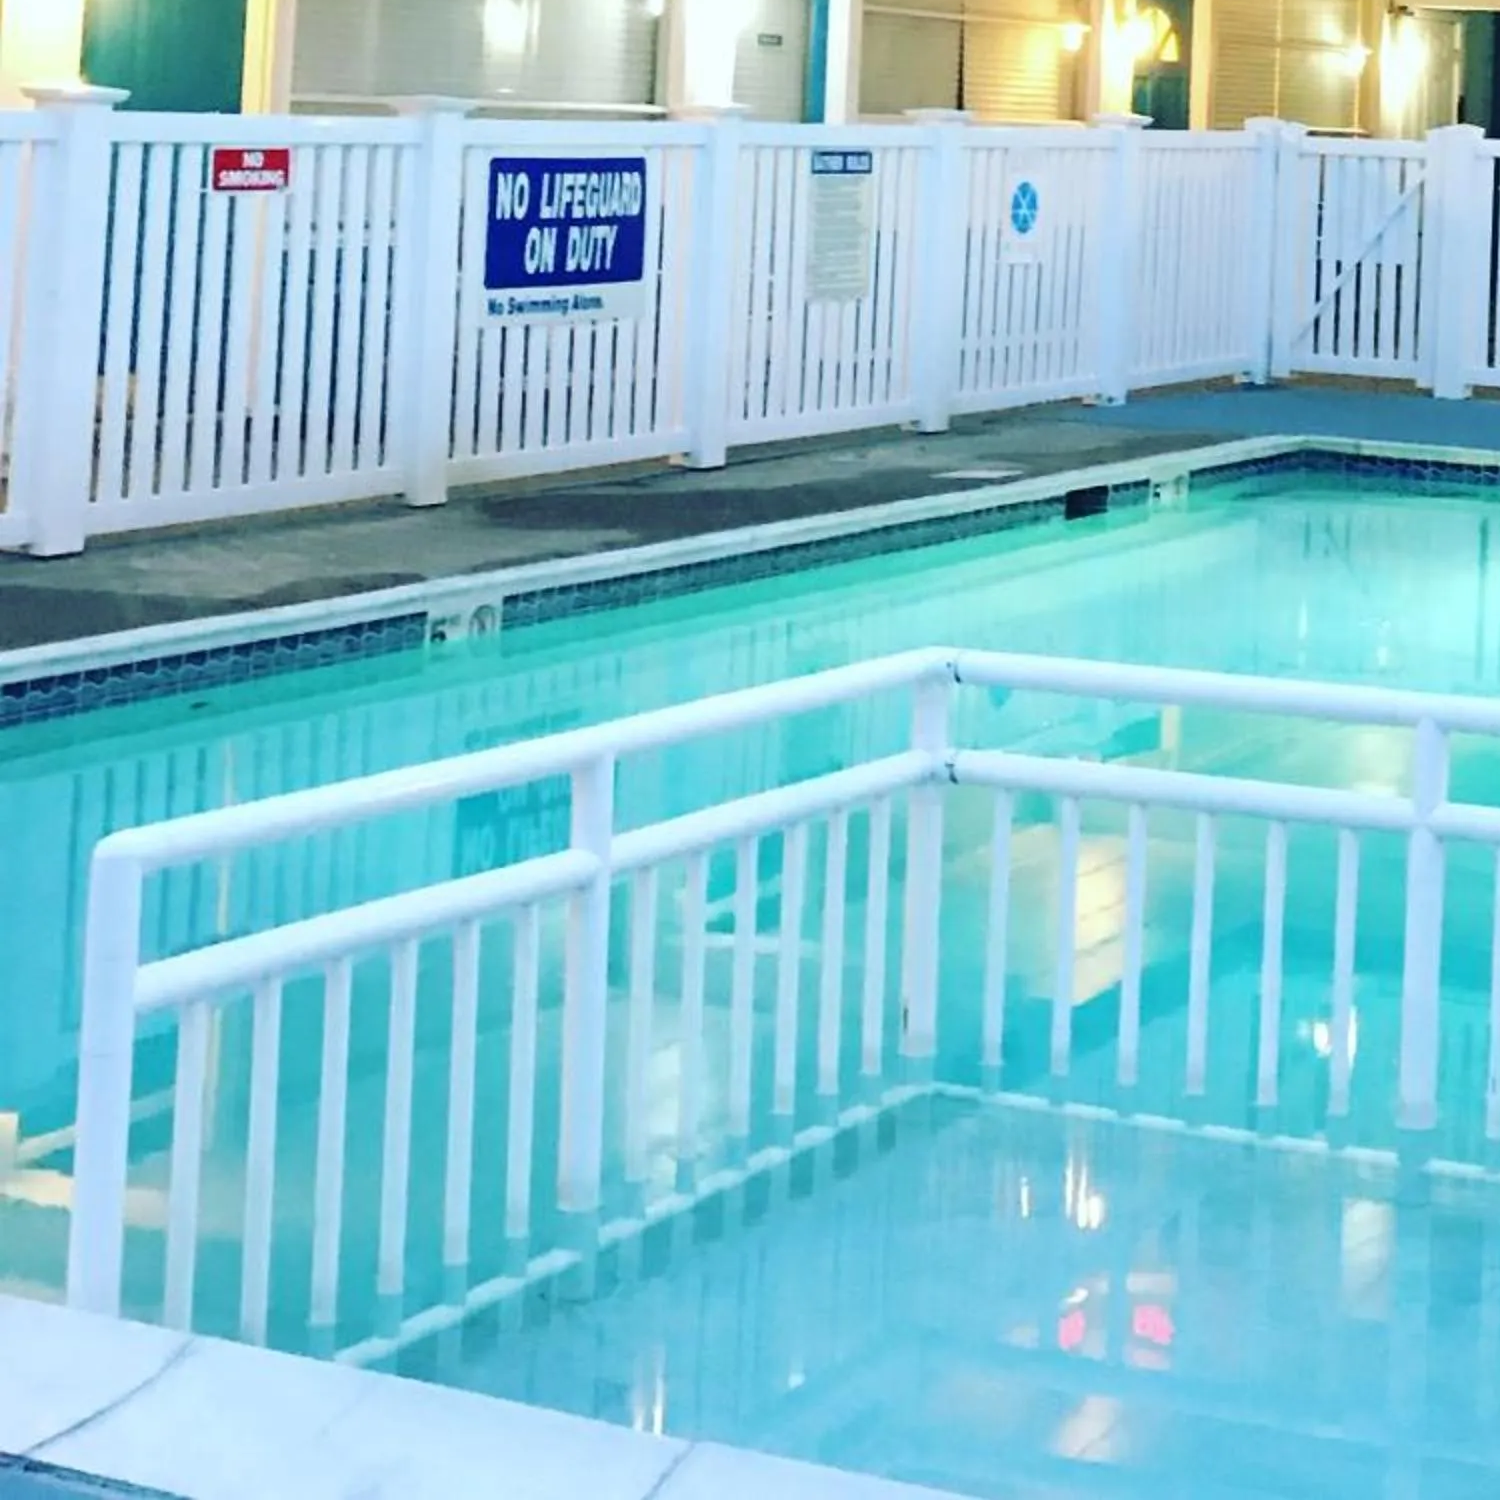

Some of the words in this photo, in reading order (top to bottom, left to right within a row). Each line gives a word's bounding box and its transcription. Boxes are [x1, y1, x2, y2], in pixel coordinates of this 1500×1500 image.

[242, 151, 264, 168] NO
[219, 169, 285, 187] SMOKING
[496, 172, 530, 220] NO
[539, 171, 642, 219] LIFEGUARD
[524, 226, 558, 275] ON
[565, 225, 618, 272] DUTY
[488, 298, 504, 315] No
[508, 296, 569, 317] Swimming
